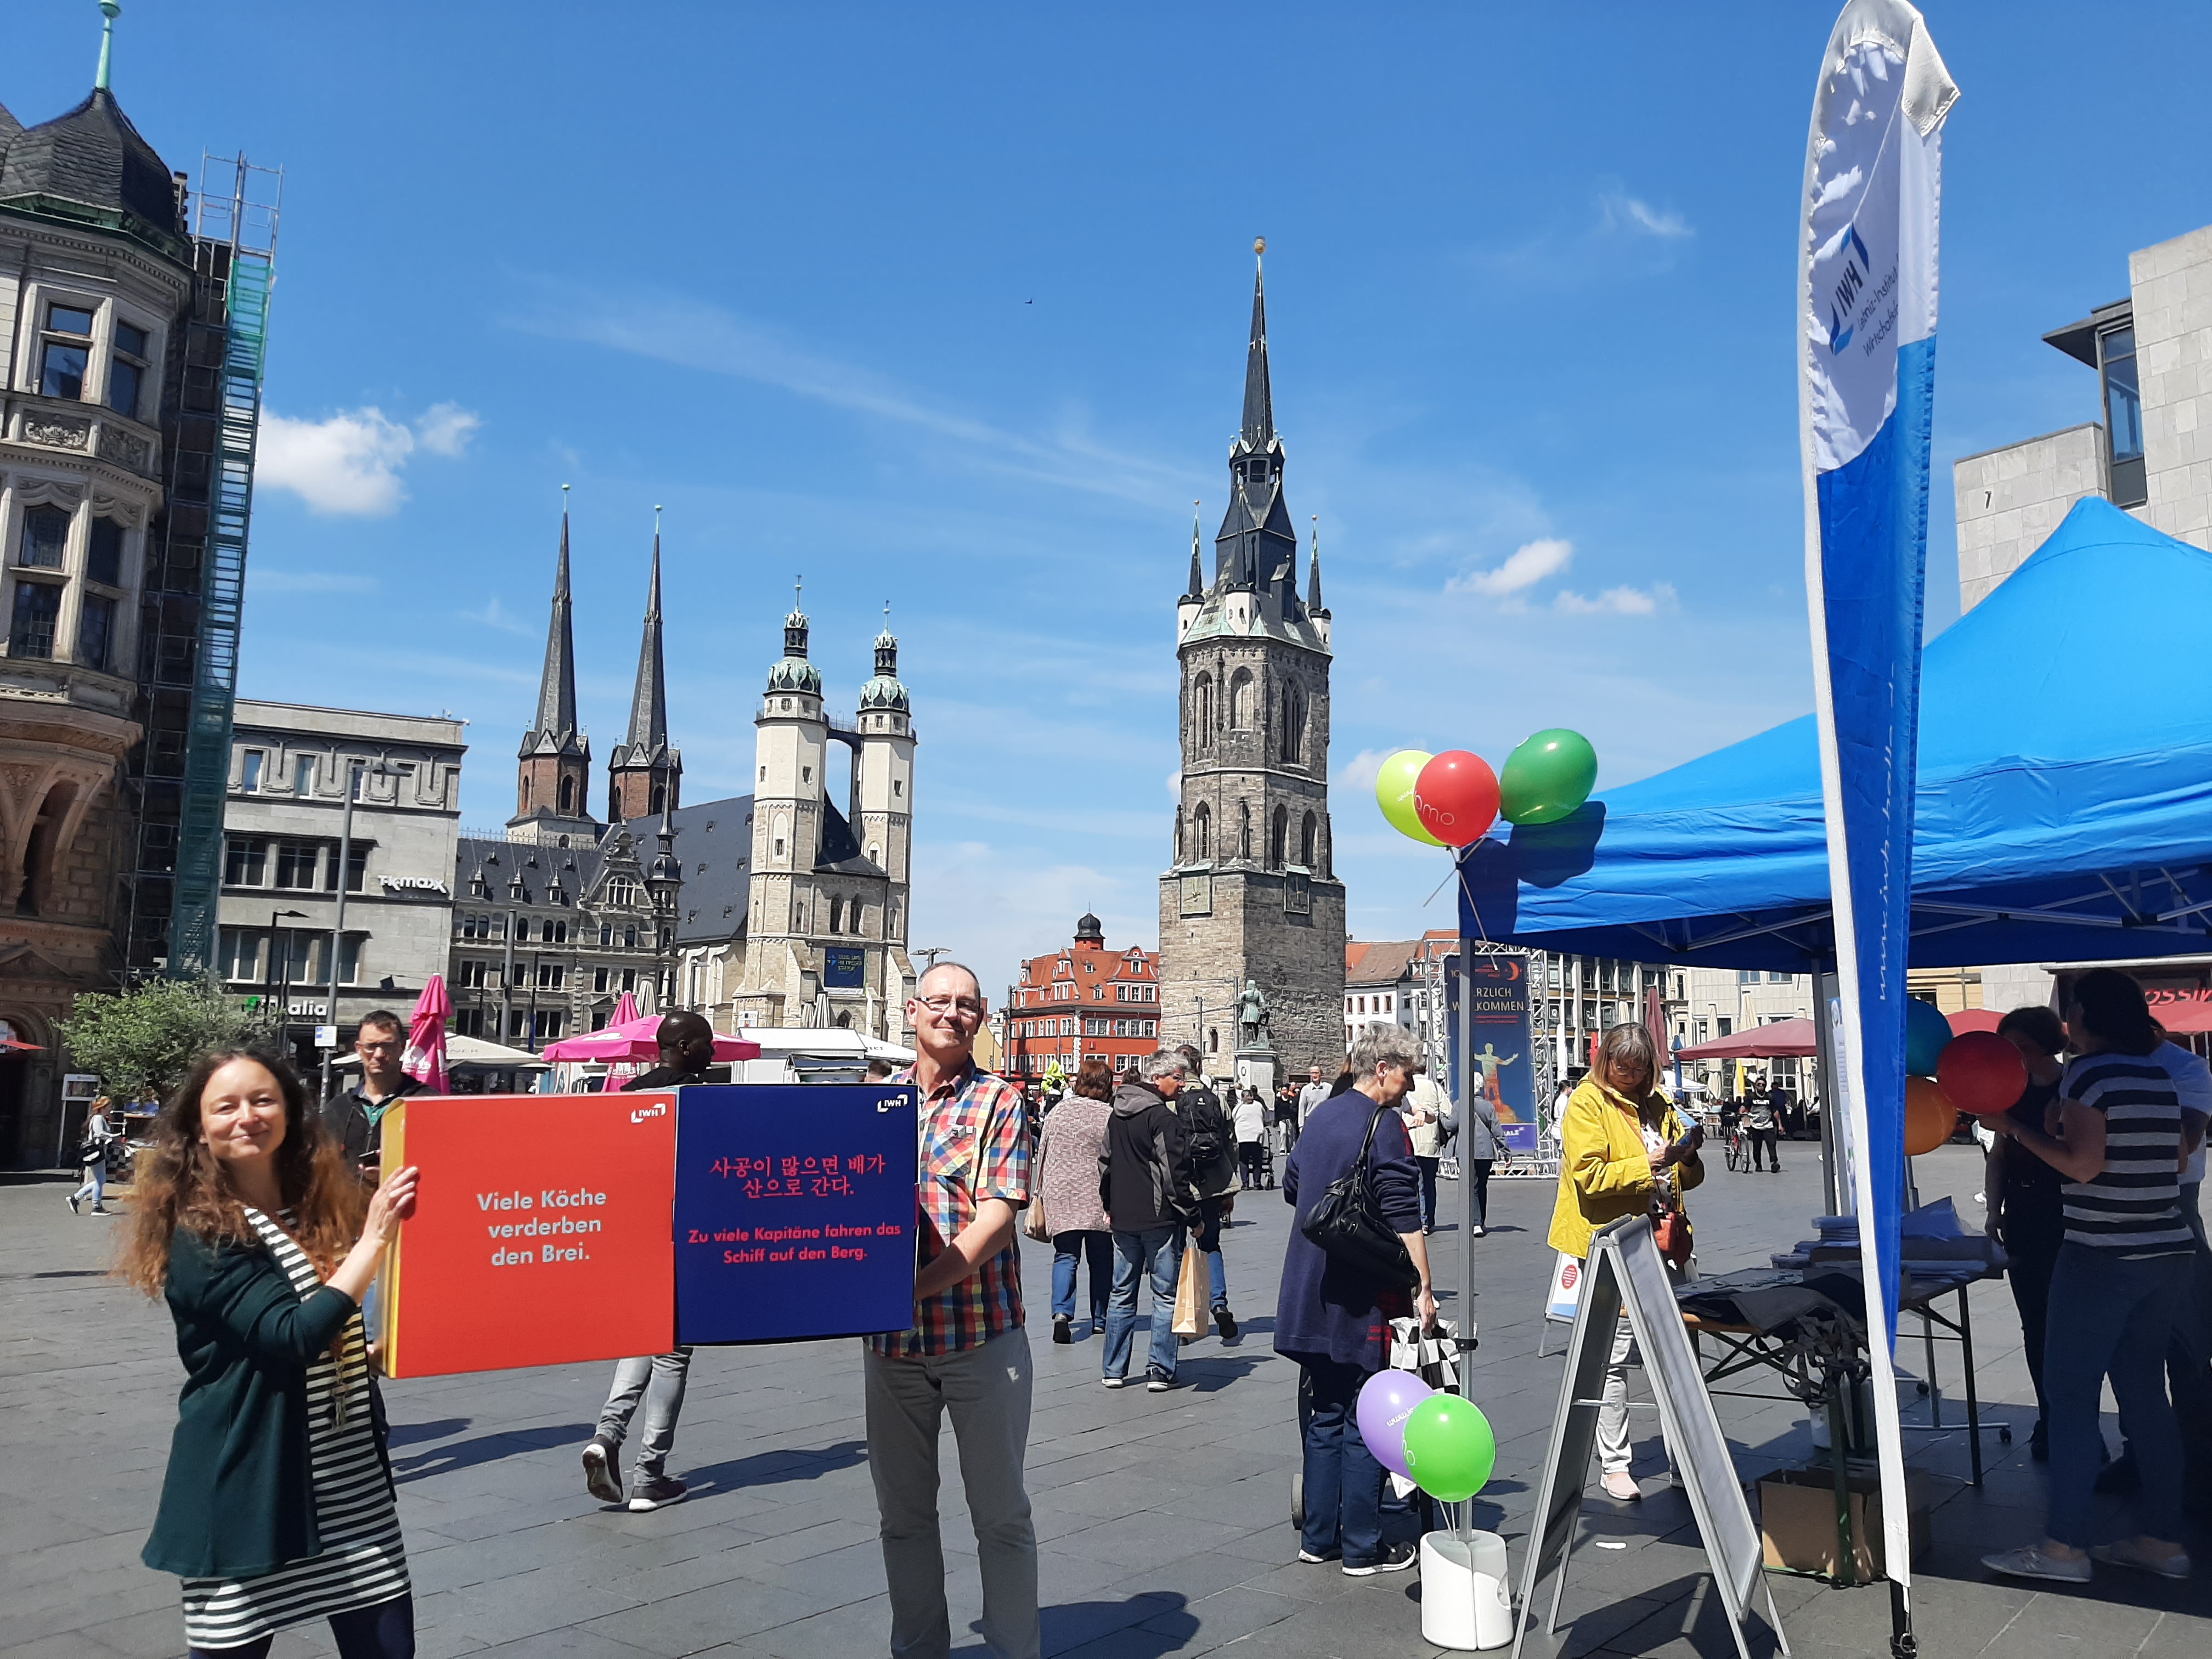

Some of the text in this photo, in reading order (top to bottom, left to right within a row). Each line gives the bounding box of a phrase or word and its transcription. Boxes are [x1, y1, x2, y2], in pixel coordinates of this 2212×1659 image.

[1835, 260, 1864, 317] IWH
[1474, 988, 1512, 997] RZLICH
[1452, 1000, 1524, 1012] WKOMMEN
[710, 1154, 886, 1179] 사공이 많으면 배가
[742, 1176, 854, 1199] 산으로 간다.
[477, 1188, 607, 1211] Viele Köche
[488, 1216, 601, 1238] verderben
[688, 1222, 901, 1244] Zu viele Kapitäne fahren das
[491, 1242, 590, 1266] den Brei.
[724, 1245, 868, 1264] Schiff auf den Berg.
